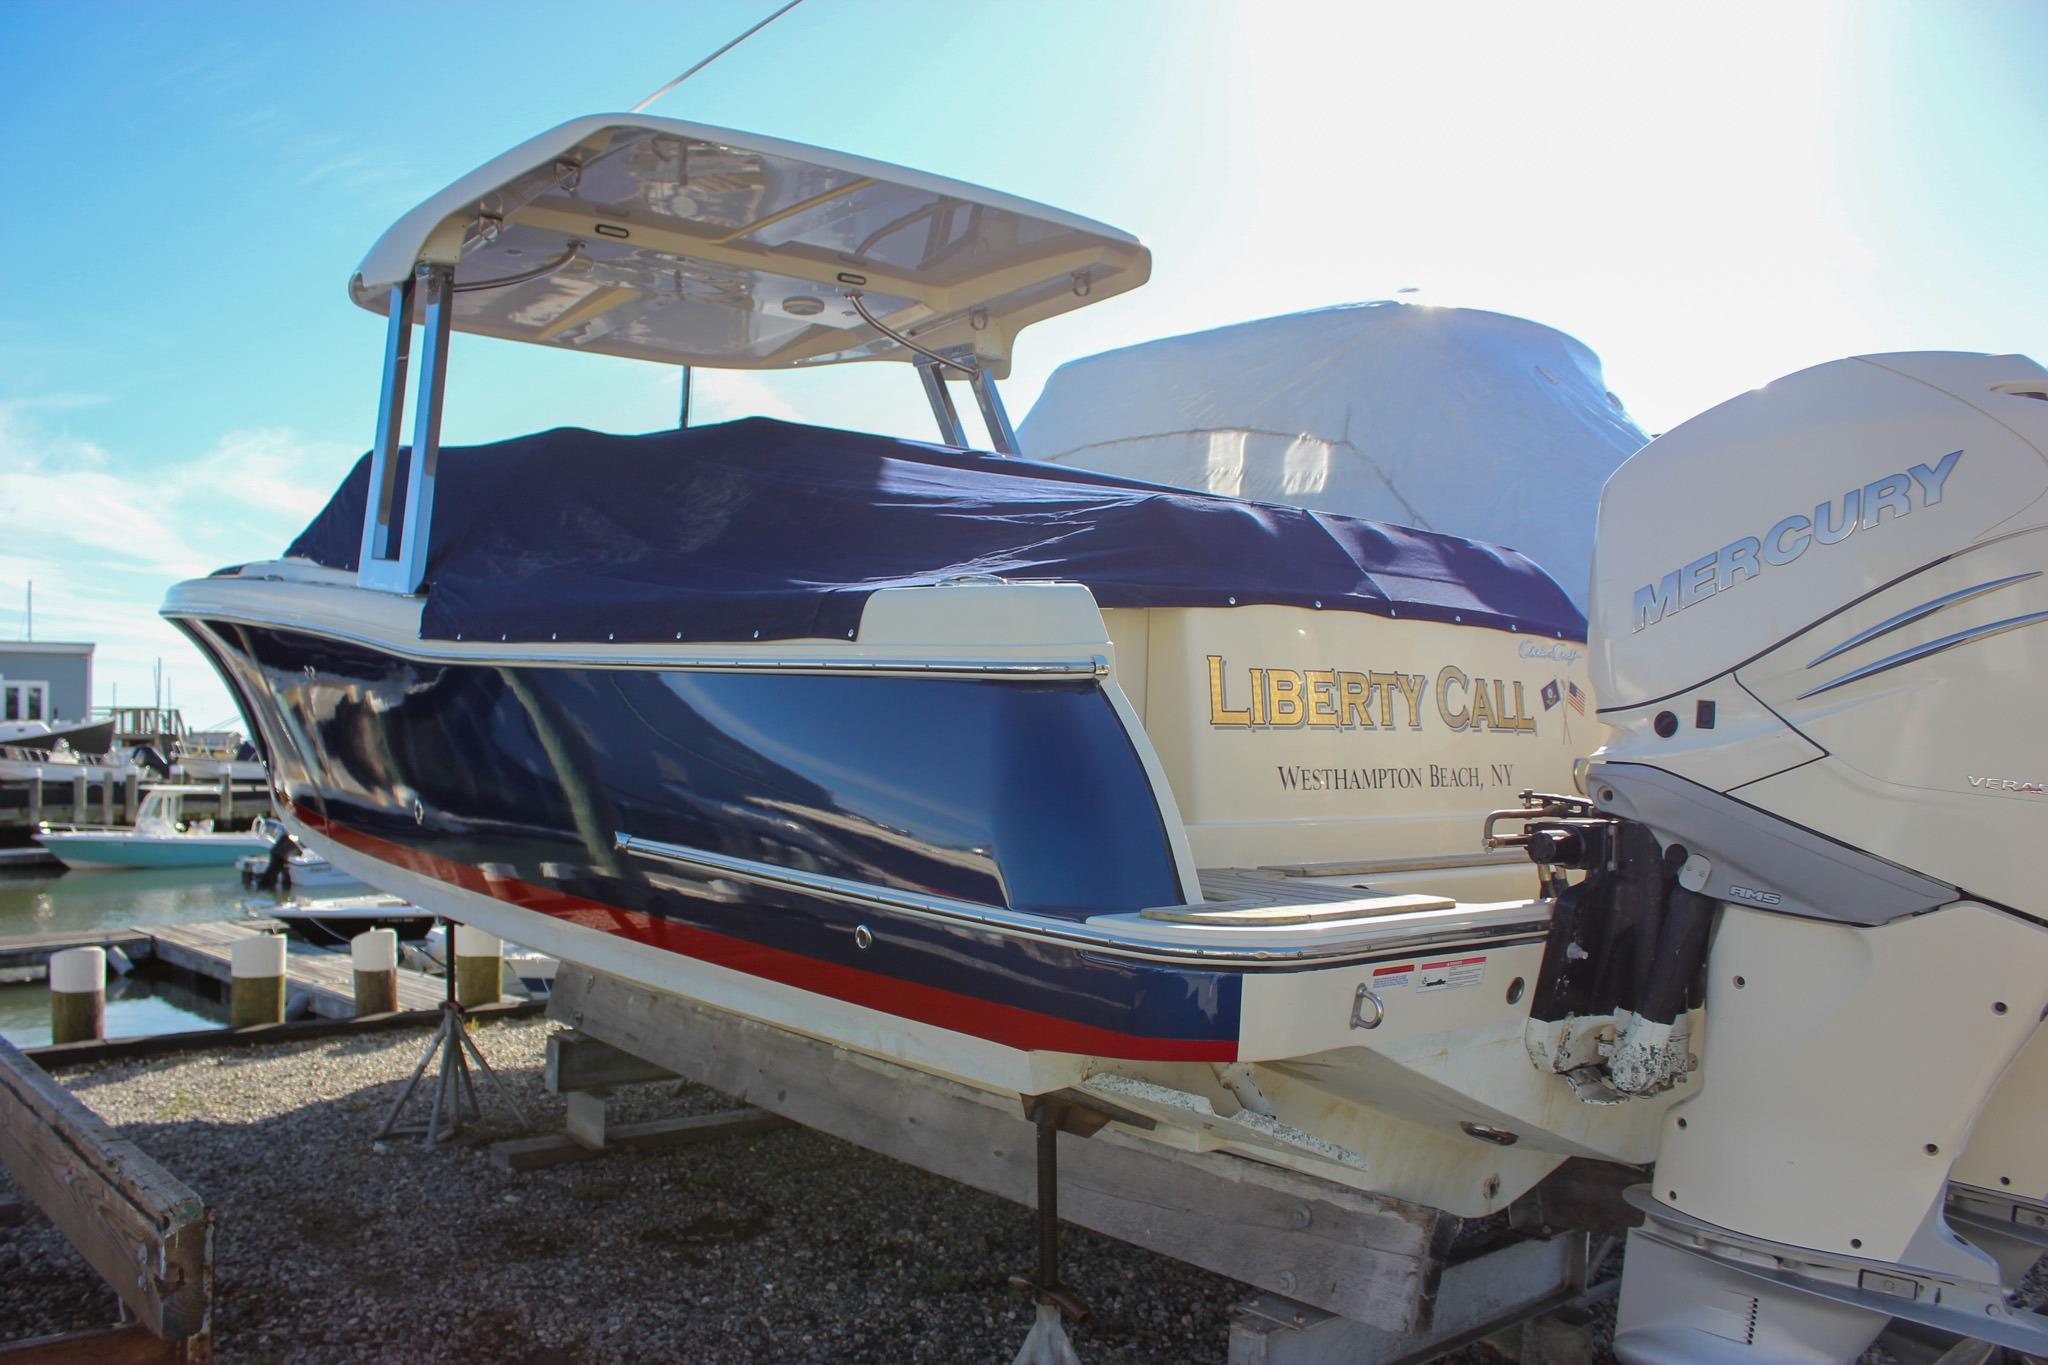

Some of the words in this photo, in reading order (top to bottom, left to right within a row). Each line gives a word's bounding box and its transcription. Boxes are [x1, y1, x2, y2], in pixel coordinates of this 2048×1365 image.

[1631, 449, 1964, 634] MERCURY
[1206, 655, 1427, 732] LIBERTY
[1436, 665, 1537, 735] CALL
[1278, 765, 1423, 792] WESTHAMPTON
[1490, 764, 1513, 787] NY
[1729, 885, 1781, 905] AMS
